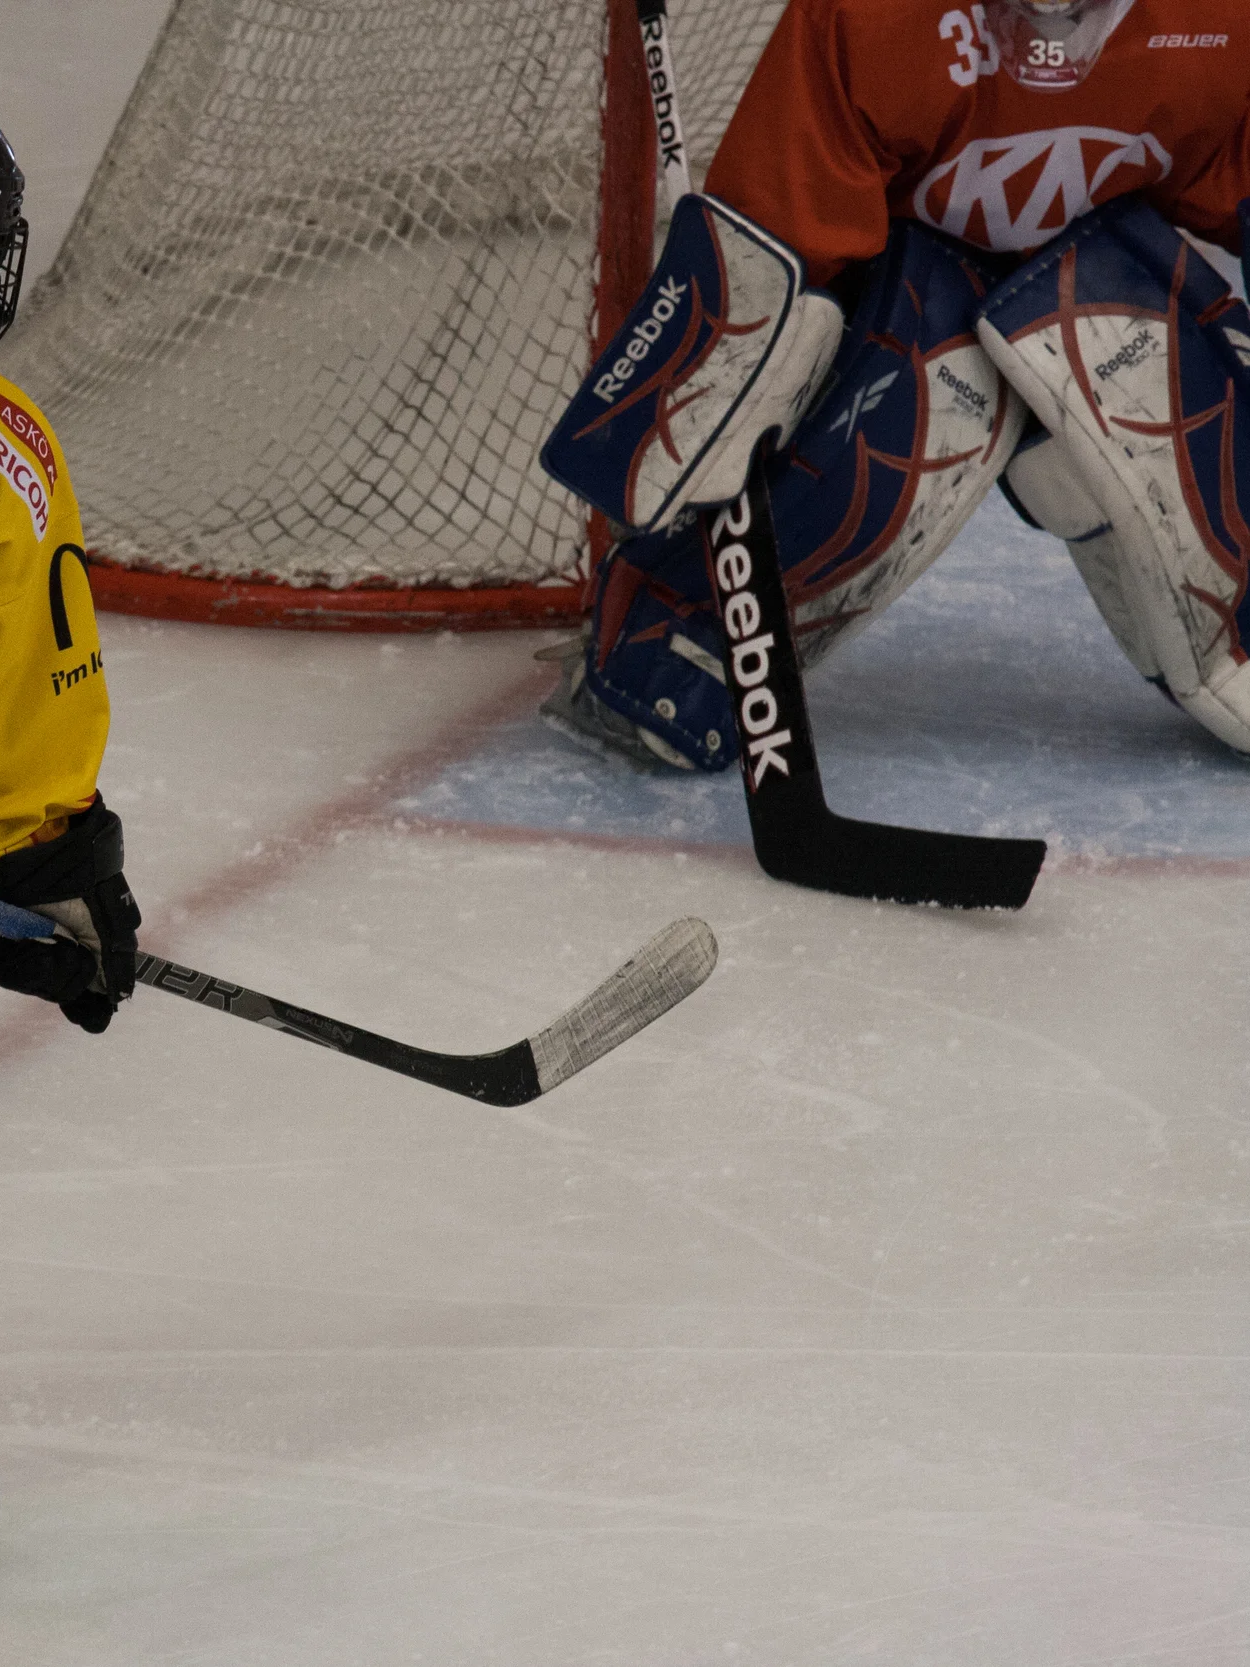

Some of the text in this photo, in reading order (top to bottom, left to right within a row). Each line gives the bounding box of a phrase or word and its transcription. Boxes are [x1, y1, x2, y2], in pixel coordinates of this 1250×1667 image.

[1027, 39, 1066, 67] 35
[1148, 34, 1228, 48] BAUER
[642, 16, 683, 169] Reebok
[593, 275, 688, 403] Reebok
[1095, 329, 1154, 381] Reebok
[937, 364, 990, 412] Reebok
[1, 406, 49, 459] ASKÖ
[710, 493, 792, 792] Reebok
[51, 663, 88, 697] i'm
